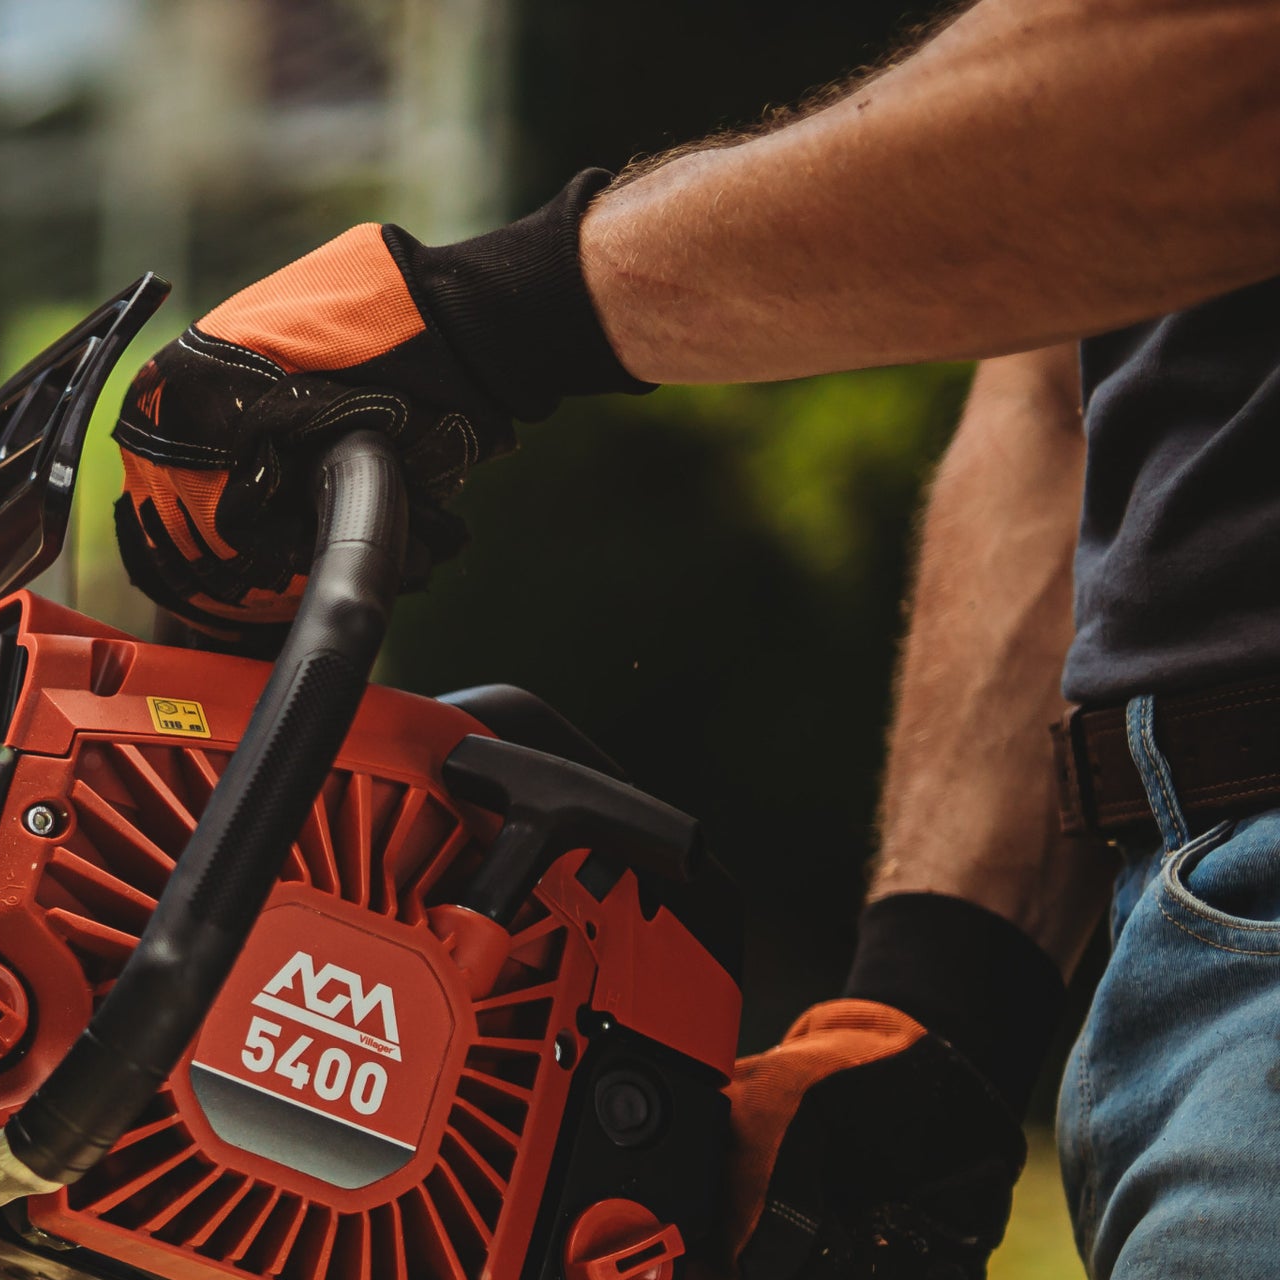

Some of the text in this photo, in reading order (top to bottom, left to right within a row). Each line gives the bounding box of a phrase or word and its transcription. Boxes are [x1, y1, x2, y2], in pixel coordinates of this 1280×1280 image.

[262, 950, 400, 1045] AGM
[359, 1033, 395, 1054] Villager
[241, 1015, 389, 1116] 5400
